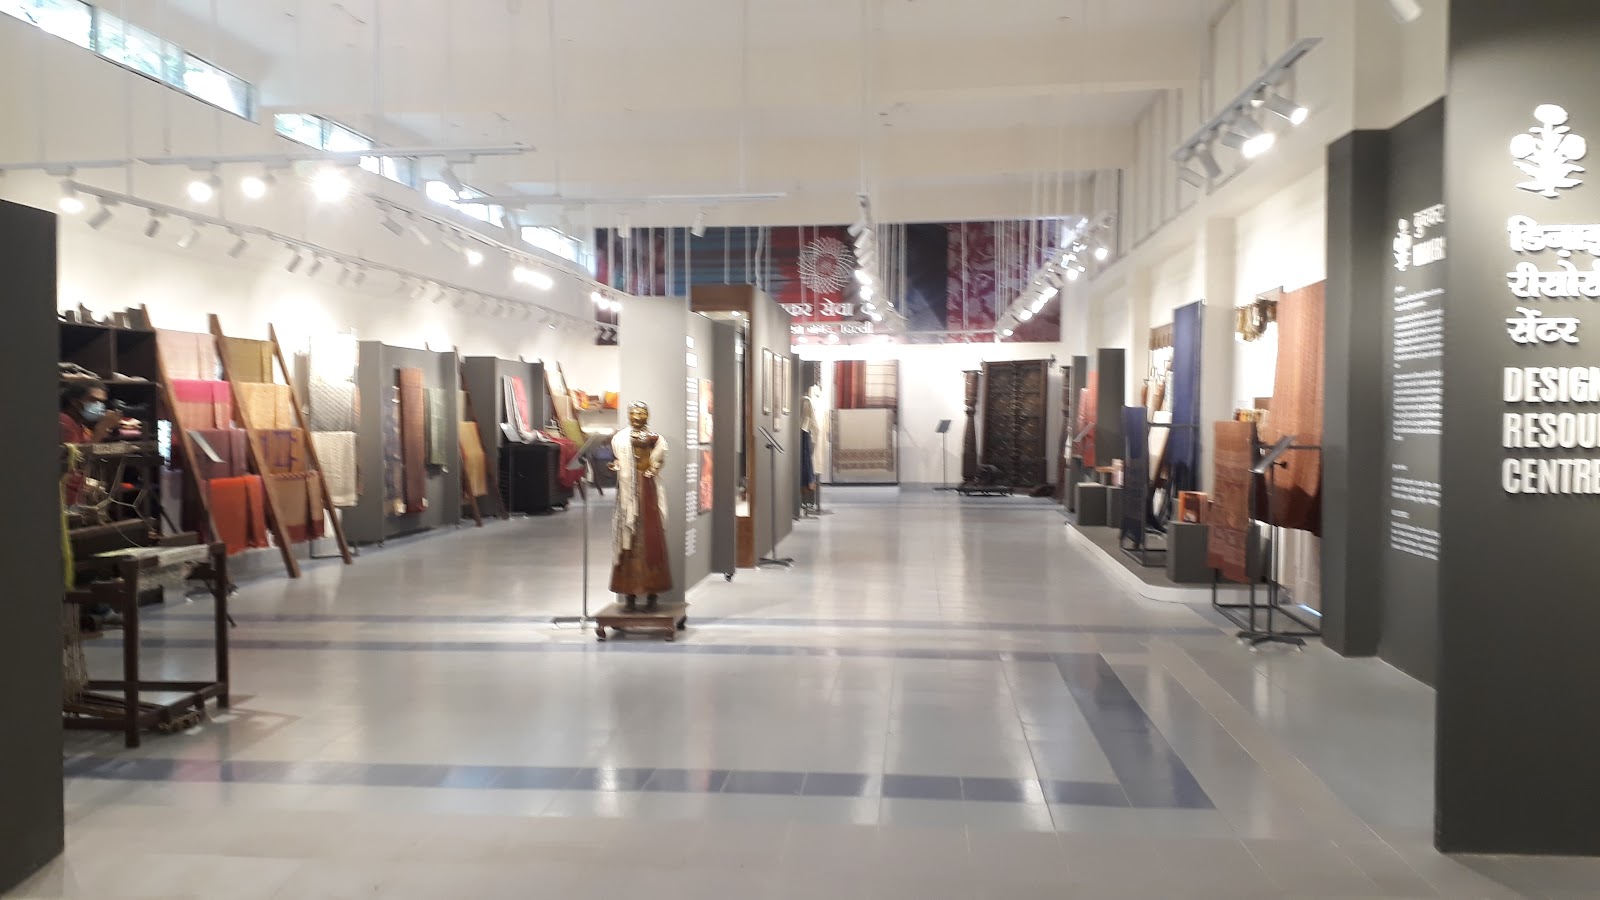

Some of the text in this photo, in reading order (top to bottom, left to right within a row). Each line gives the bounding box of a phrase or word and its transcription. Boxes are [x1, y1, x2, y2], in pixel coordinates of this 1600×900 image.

[1506, 306, 1580, 343] सेंटर
[1502, 412, 1600, 448] RESOU
[1502, 458, 1600, 494] CENTRE
